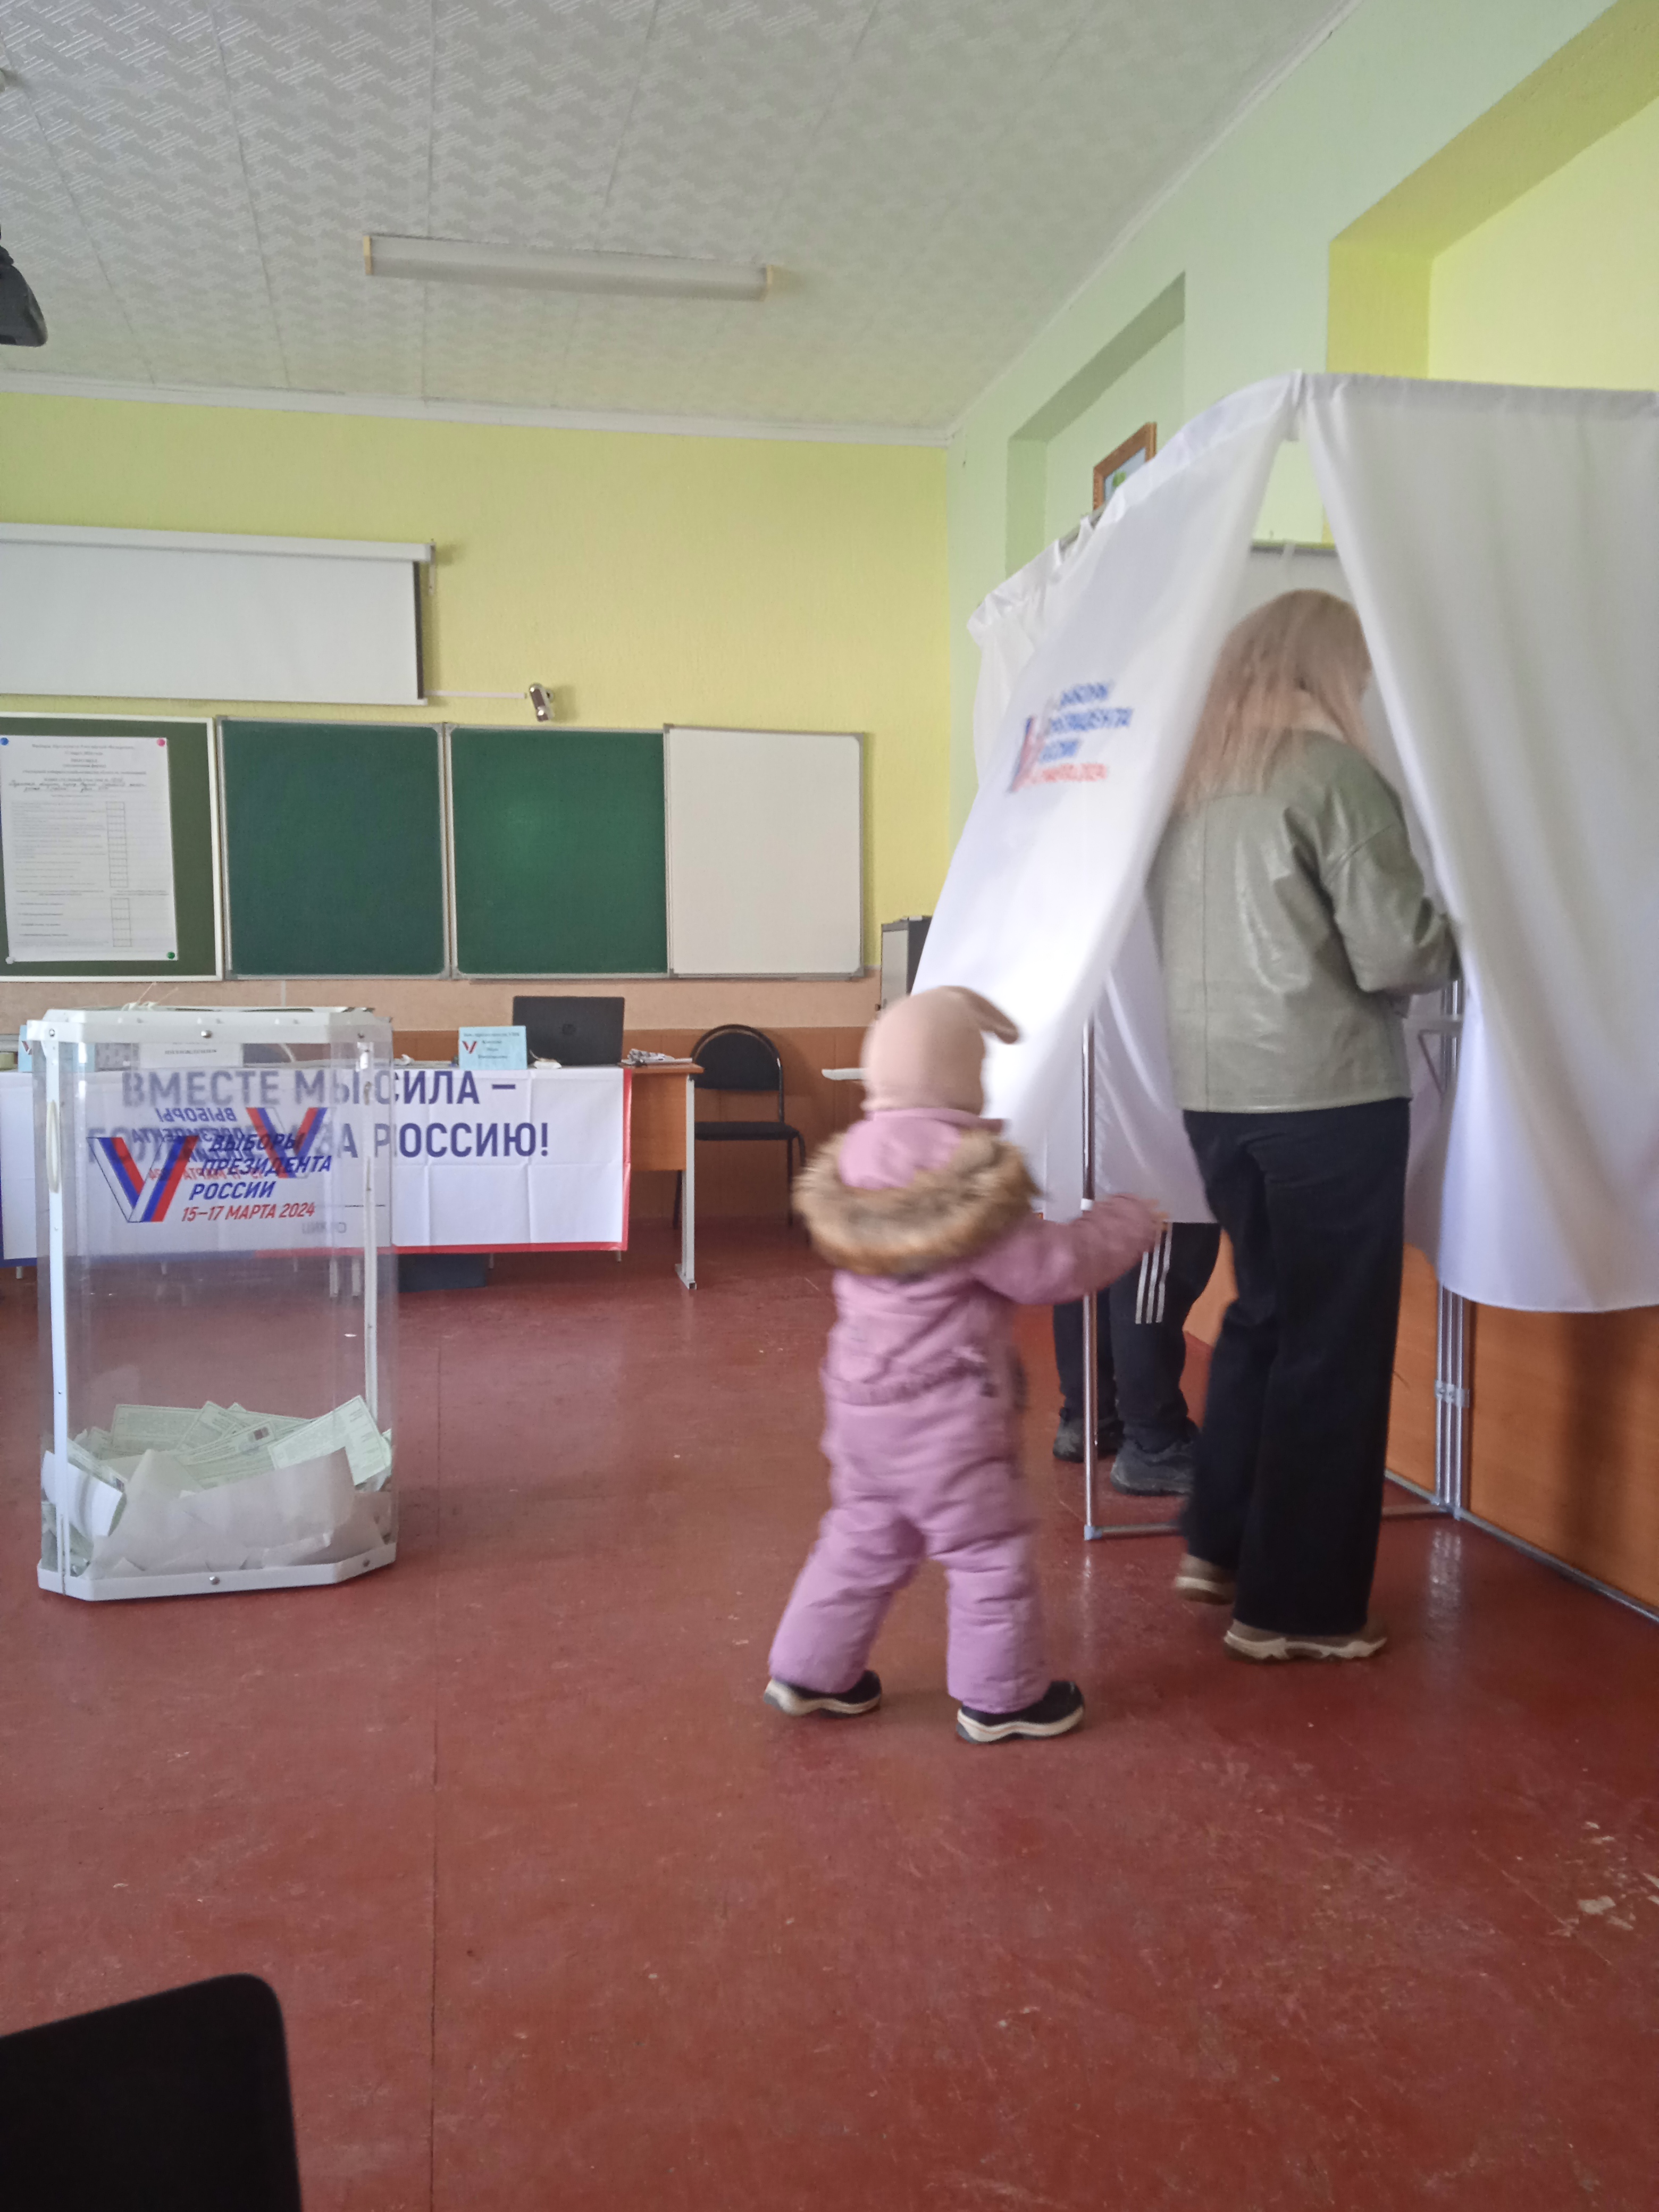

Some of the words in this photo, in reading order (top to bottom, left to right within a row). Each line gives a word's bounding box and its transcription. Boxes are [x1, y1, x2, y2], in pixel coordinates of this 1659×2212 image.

[122, 1071, 280, 1107] ВМЕСТЕ
[294, 1070, 360, 1104] МЫ
[375, 1070, 480, 1104] СИЛА
[375, 1122, 549, 1158] РОССИЮ!
[201, 1155, 332, 1176] ПРЕЗИДЕНТА
[189, 1181, 276, 1200] РОССИИ
[225, 1203, 277, 1220] МАРТА
[279, 1202, 315, 1218] 2024
